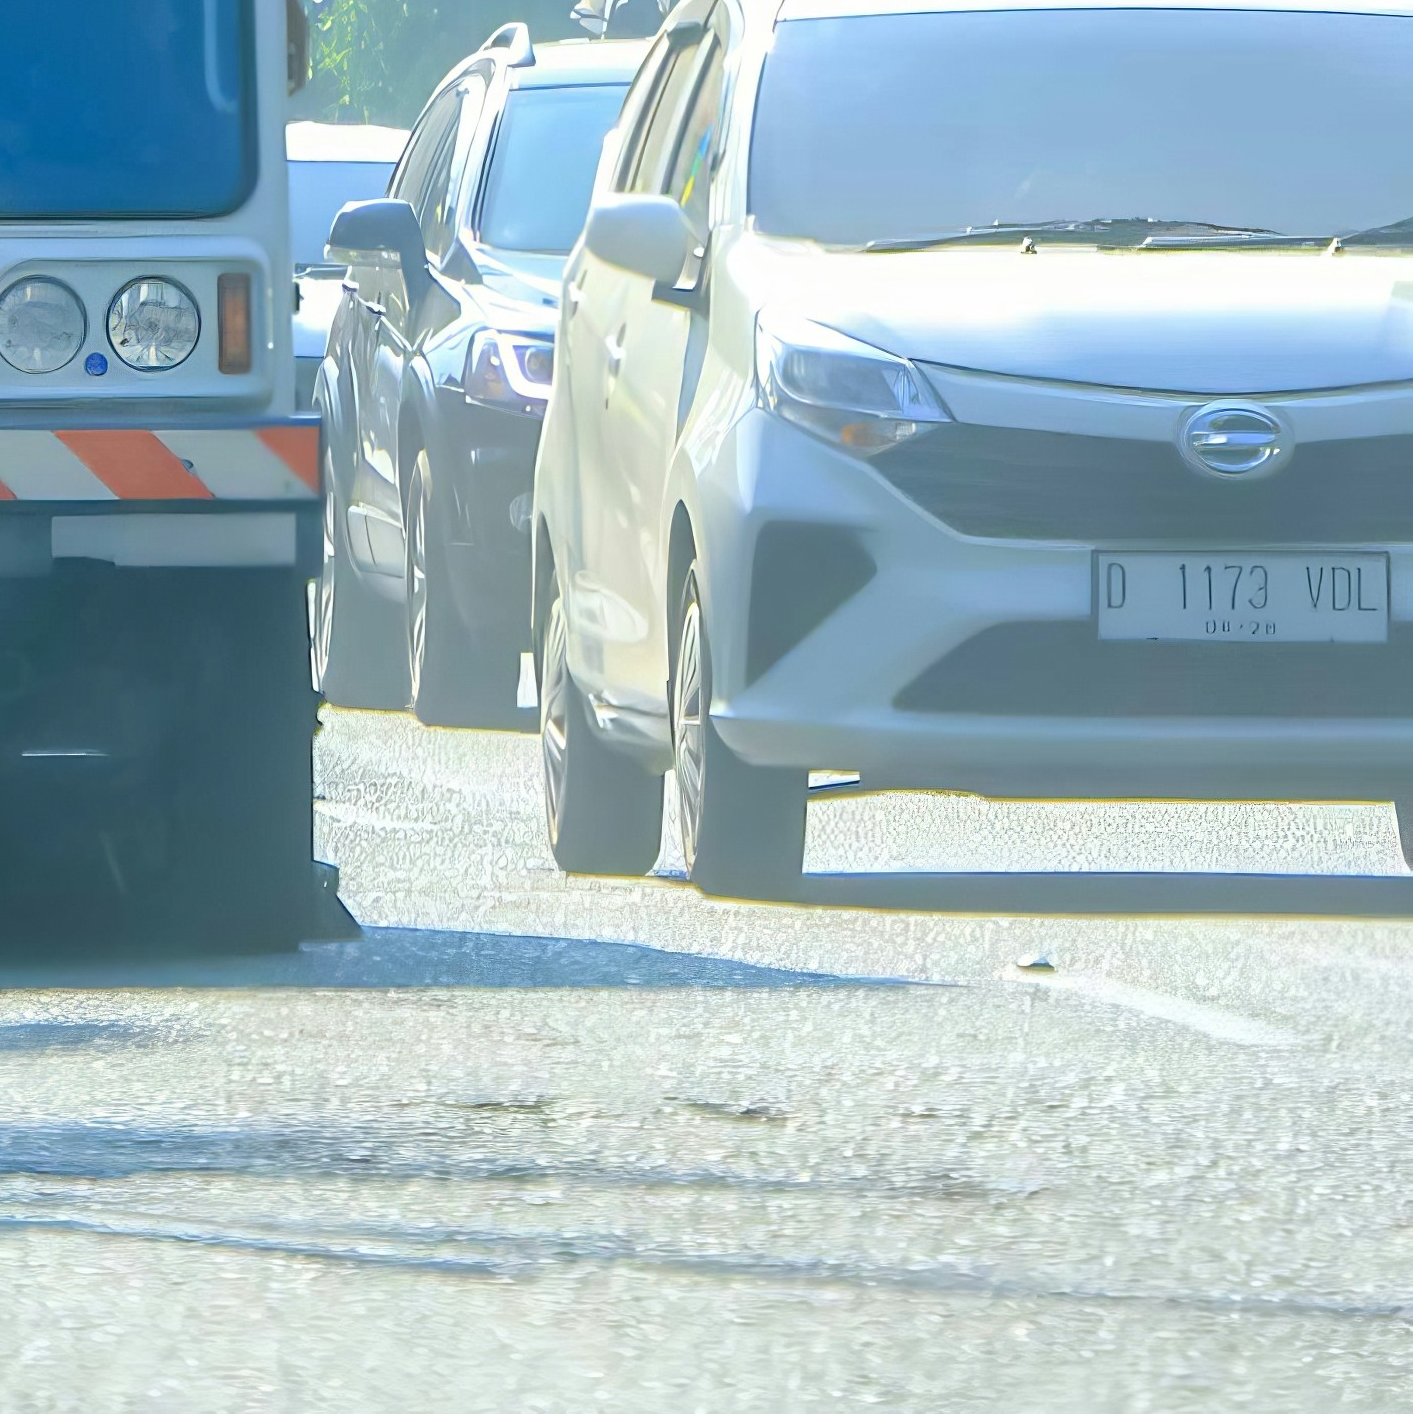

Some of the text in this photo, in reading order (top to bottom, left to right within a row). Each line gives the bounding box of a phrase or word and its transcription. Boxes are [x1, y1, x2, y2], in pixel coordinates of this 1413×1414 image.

[1106, 562, 1378, 611] D 1173 VDL
